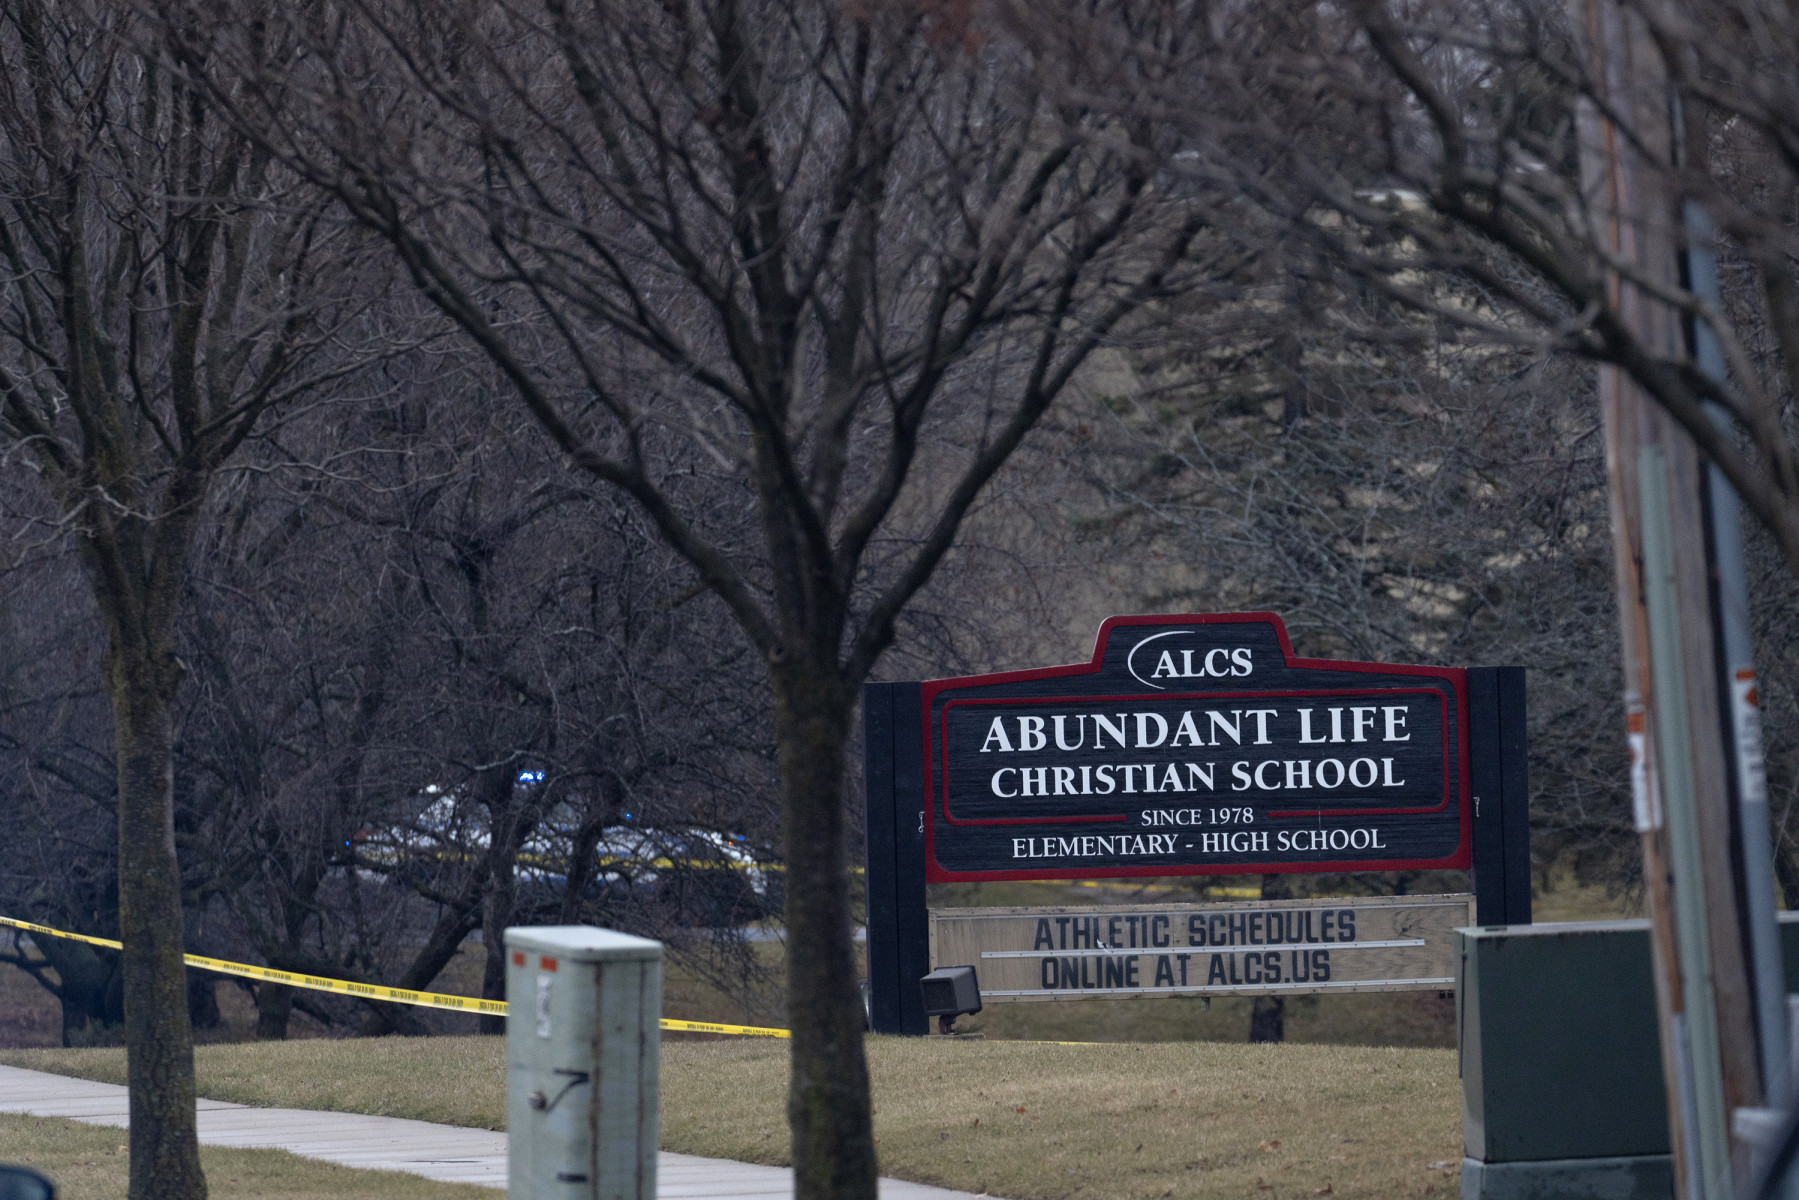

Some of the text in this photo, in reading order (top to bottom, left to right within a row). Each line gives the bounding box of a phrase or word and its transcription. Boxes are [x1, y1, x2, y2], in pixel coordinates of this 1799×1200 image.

[1150, 647, 1253, 679] ALCS
[979, 705, 1411, 753] ABUNDANT LIFE
[991, 757, 1406, 798] CHRISTIAN SCHOOL
[1141, 807, 1254, 827] SINCE 1978
[1011, 834, 1179, 859] ELEMENTARY
[1201, 831, 1270, 853] HIGH
[1277, 828, 1387, 851] SCHOOL
[1034, 909, 1356, 950] ATHLETIC SCHEDULES
[1041, 949, 1331, 989] ONLINE AT ALCS.US
